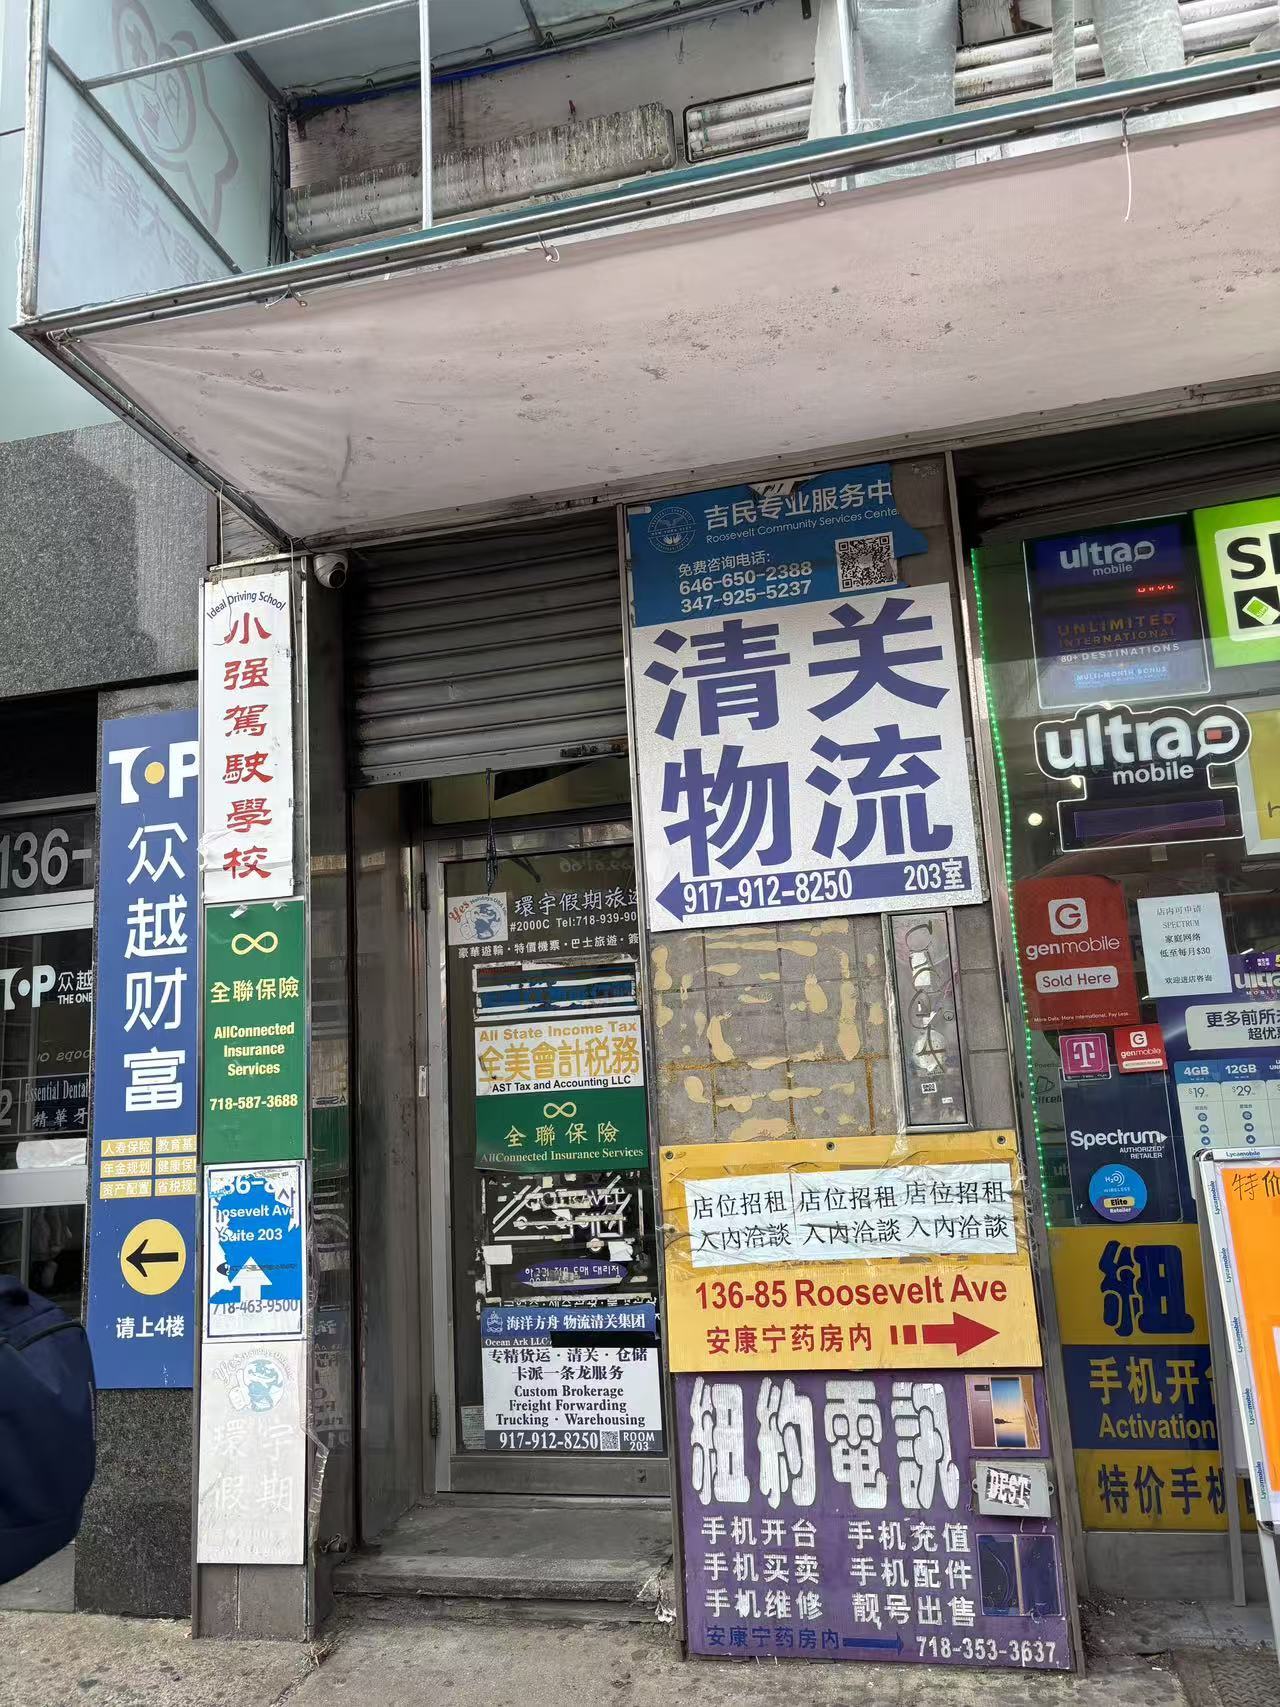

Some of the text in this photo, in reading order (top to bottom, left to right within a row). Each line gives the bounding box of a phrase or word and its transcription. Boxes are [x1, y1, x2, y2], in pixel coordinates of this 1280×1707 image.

[704, 479, 893, 531] 吉民专业服务中
[706, 528, 755, 544] Roosevelt
[758, 519, 816, 535] Community
[819, 512, 862, 526] Services
[1060, 541, 1133, 570] ultra
[679, 561, 812, 596] 646-650-2388
[1092, 563, 1133, 577] mobile
[206, 591, 286, 619] Ideal Driving School
[680, 580, 812, 614] 347-925-5237
[1057, 613, 1177, 637] UNLIMITED
[1058, 628, 1177, 649] INTERNATIONAL
[1060, 643, 1180, 664] 80+ DESTINATIONS
[643, 597, 950, 741] 清关
[1045, 713, 1194, 770] ultra
[1113, 762, 1194, 785] mobile
[661, 724, 953, 877] 物流
[683, 858, 965, 914] 917-912-8250 203室
[1162, 919, 1200, 929] SPECTRUM
[124, 822, 189, 1112] 众越财富
[210, 976, 300, 1004] 全聯保險
[1043, 971, 1112, 988] Sold Here
[57, 994, 74, 1005] THE
[214, 1022, 295, 1040] AllConnected
[480, 1020, 637, 1042] All State Income Tax
[223, 1043, 285, 1058] Insurance
[227, 1062, 281, 1077] Services
[1184, 1067, 1209, 1076] 4GB
[1225, 1064, 1257, 1074] 12GB
[25, 1079, 88, 1102] Essential Dental
[492, 1074, 631, 1093] AST Tax and Accounting LLC
[209, 1093, 299, 1111] 718-587-3688
[158, 1137, 197, 1152] 教育基
[503, 1120, 620, 1148] 全聯保險
[1071, 1129, 1160, 1150] Spectrum
[103, 1140, 151, 1155] 人寿保险
[480, 1147, 644, 1163] AllConnected Insurance Services
[103, 1161, 150, 1176] 年金规划
[158, 1159, 197, 1173] 健康保
[157, 1179, 197, 1193] 省税规
[904, 1180, 1006, 1206] 店位招租
[1210, 1180, 1220, 1215] Lycamobile
[693, 1190, 787, 1221] 店位招租
[799, 1185, 898, 1213] 店位招租
[257, 1228, 283, 1241] 203
[1222, 1247, 1231, 1283] Lycamobile
[695, 1273, 1008, 1310] 136-85 Roosevelt Ave
[116, 1315, 184, 1339] 请上4楼
[506, 1313, 645, 1331] 海洋方舟 物流清关集团
[485, 1338, 511, 1346] Ocean
[513, 1338, 528, 1346] Ark
[706, 1323, 872, 1355] 安康宁药房内
[1231, 1316, 1242, 1353] Lycamobile
[488, 1348, 648, 1364] 专精货运 清关 仓储
[511, 1365, 624, 1381] 卡派一条龙服务
[1089, 1356, 1216, 1405] 手机开
[514, 1385, 624, 1399] Custom Brokerage
[509, 1399, 628, 1414] Freight Forwarding
[1243, 1387, 1255, 1425] Lycamobile
[496, 1413, 646, 1428] Trucking Warehousing
[1099, 1413, 1217, 1440] Activation
[499, 1431, 599, 1450] 917-912-8250
[623, 1431, 655, 1442] ROOM
[629, 1441, 649, 1450] 203
[1256, 1460, 1267, 1499] Lycamobile
[702, 1515, 971, 1553] 手机开台 手机充值
[704, 1552, 973, 1590] 手机买卖 手机配件
[704, 1588, 976, 1629] 手机维修 靓号出售
[705, 1624, 1056, 1666] 安康宁药房内 718-353-3637
